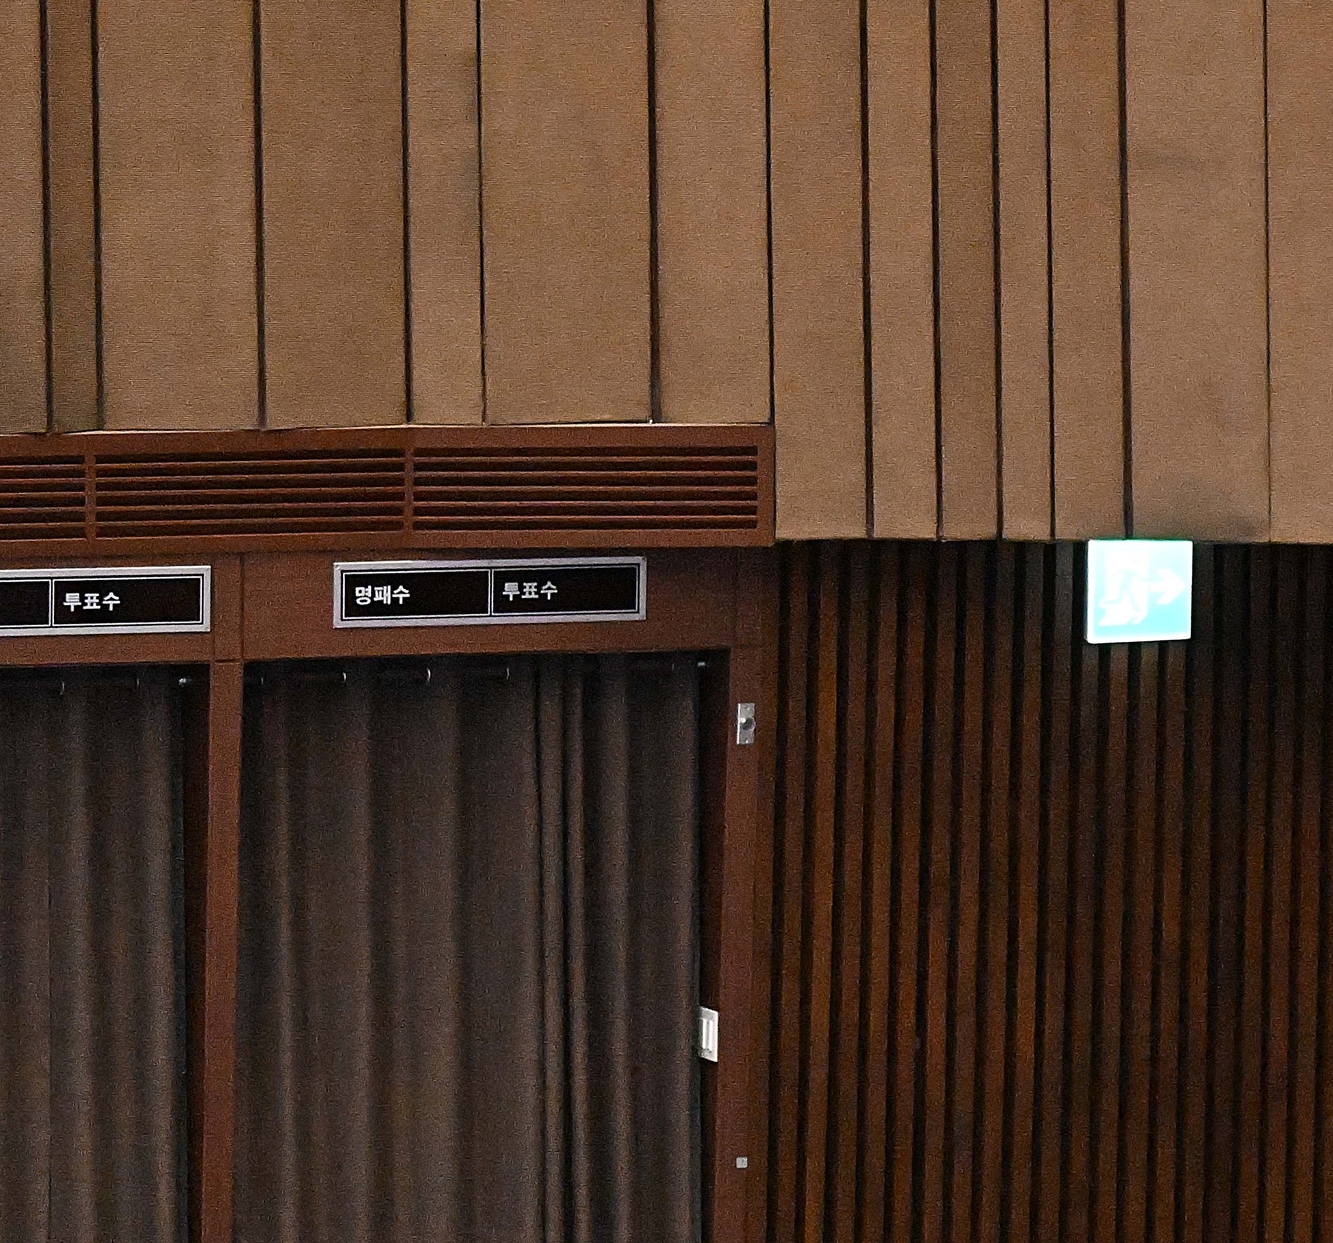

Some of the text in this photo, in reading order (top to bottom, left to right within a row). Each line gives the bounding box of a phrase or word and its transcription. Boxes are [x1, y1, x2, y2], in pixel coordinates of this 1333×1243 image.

[62, 591, 121, 612] 투표수
[355, 585, 411, 606] 명패수
[502, 580, 558, 602] 투표수
